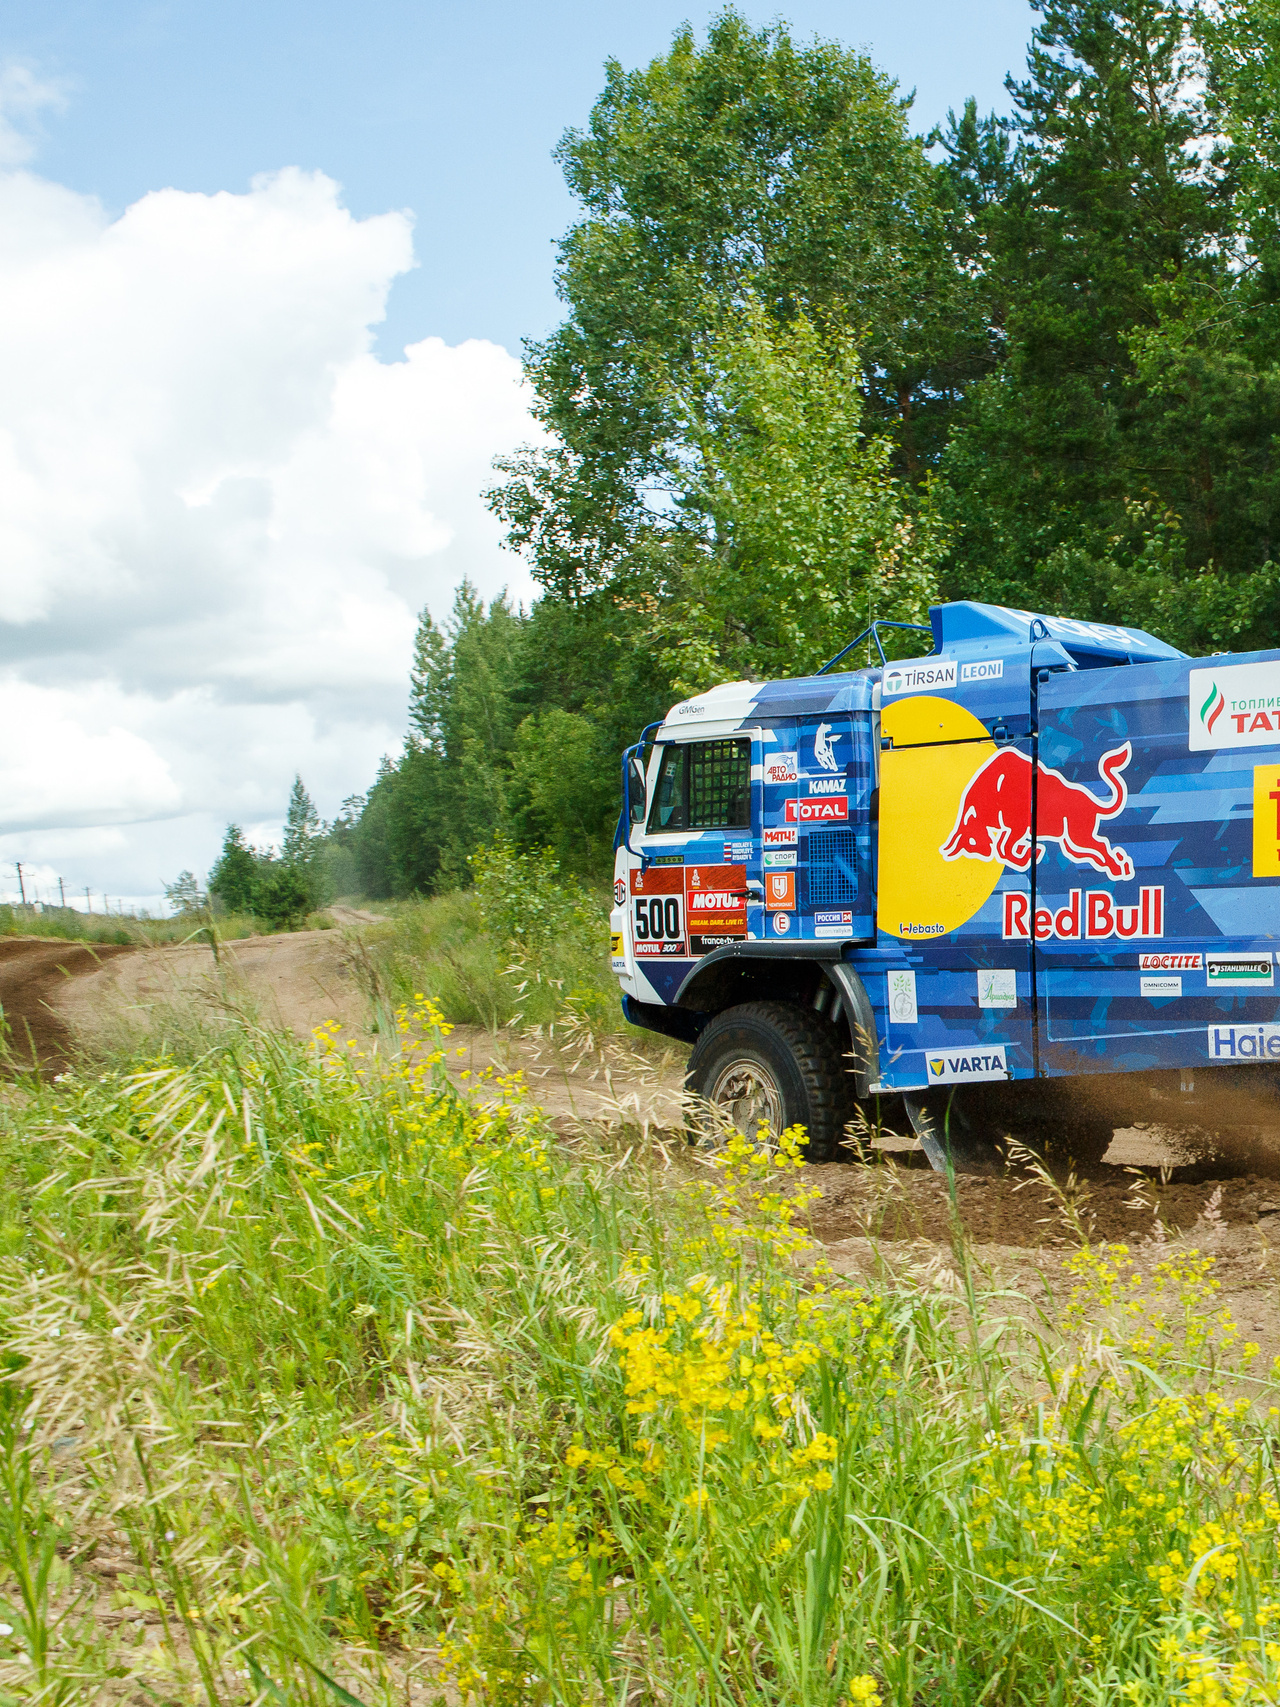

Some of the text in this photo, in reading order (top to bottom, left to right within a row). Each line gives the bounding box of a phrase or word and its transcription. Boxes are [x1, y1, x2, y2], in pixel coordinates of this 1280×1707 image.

[963, 663, 1001, 679] LEONI
[766, 765, 787, 775] АВТО
[772, 773, 797, 782] РАДИО
[809, 779, 847, 794] KAMAZ
[788, 803, 845, 818] TOTAL
[764, 831, 795, 843] МАТЧ!
[692, 893, 740, 909] MOTUL
[636, 898, 681, 939] 500
[817, 913, 851, 923] РОССИЯ 24
[1004, 887, 1163, 939] Red Bull
[779, 917, 786, 930] E
[899, 922, 945, 935] Webasto
[636, 943, 683, 953] MOTUL 300V
[1142, 955, 1200, 969] LOCTITE
[1220, 963, 1260, 973] STAHLWILLE
[947, 1055, 1004, 1074] VARTA
